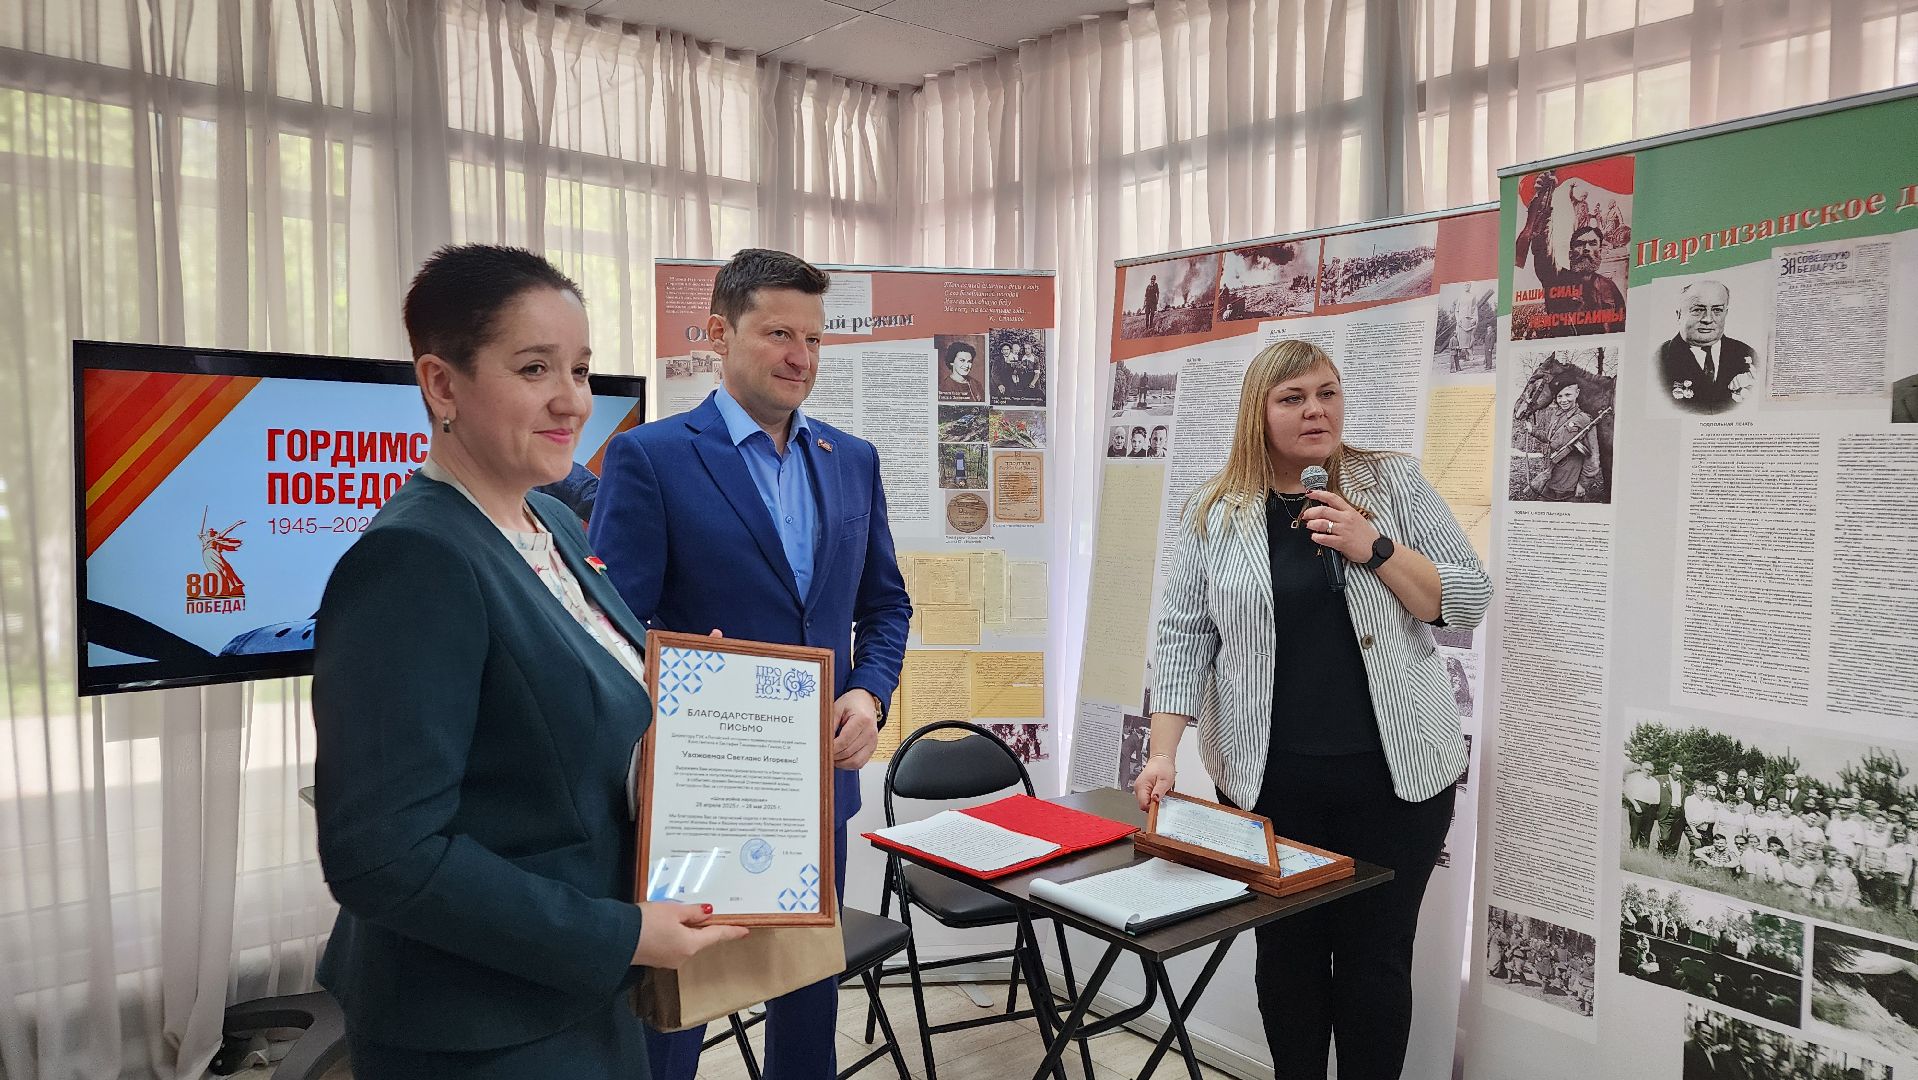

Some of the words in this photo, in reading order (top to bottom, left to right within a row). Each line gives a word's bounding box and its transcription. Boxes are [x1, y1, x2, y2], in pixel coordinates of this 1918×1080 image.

[1634, 191, 1886, 268] Партизанское
[1516, 288, 1544, 302] НАШИ
[1549, 284, 1583, 299] СИЛЫ
[852, 313, 915, 332] режим
[268, 516, 374, 535] 1945–202
[187, 573, 218, 598] 80
[186, 599, 245, 614] ПОБЕДА!
[687, 708, 794, 724] БЛАГОДАРСТВЕННОЕ
[719, 722, 763, 733] ПИСЬМО
[682, 750, 725, 760] Уважаемая
[726, 753, 761, 762] Светлана
[763, 756, 799, 764] Игоревна!
